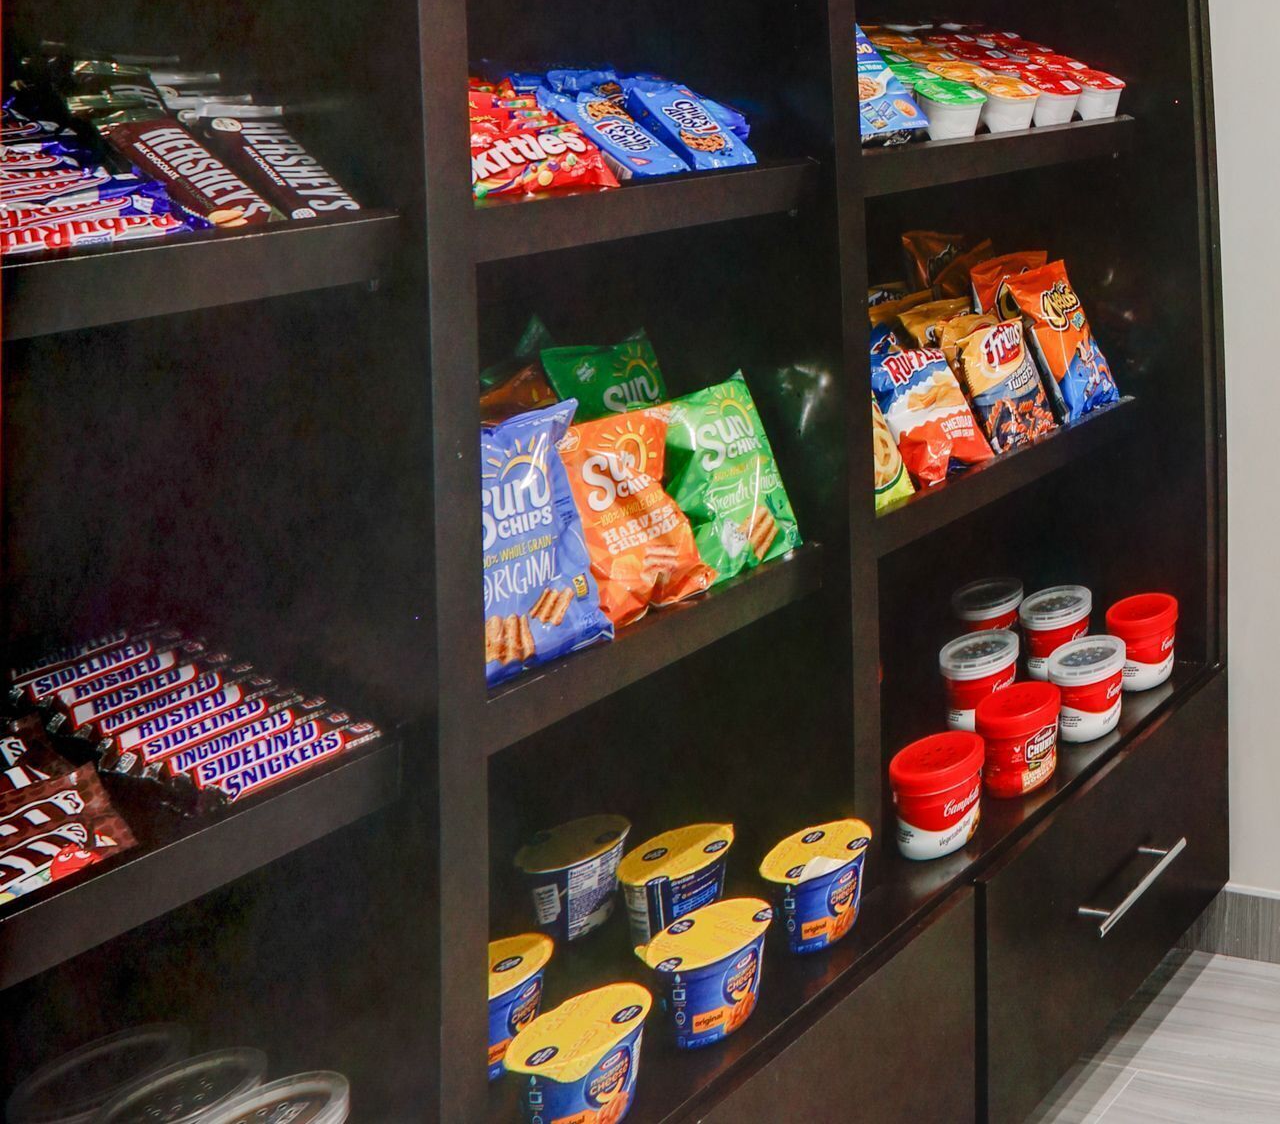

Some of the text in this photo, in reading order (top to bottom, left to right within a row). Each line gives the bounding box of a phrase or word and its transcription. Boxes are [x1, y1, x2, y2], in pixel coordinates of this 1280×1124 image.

[139, 128, 271, 218] HERSHEY'S
[146, 151, 180, 180] CHOCOLATE
[240, 122, 360, 211] HERSHEY'S
[472, 132, 587, 184] kittles
[980, 322, 1022, 368] Fritos
[603, 375, 660, 414] Sun
[1004, 366, 1034, 392] TWISTS
[697, 416, 755, 472] Sun
[941, 415, 973, 434] CHEDDAR
[617, 472, 654, 498] CHIP
[497, 507, 553, 540] CHIPS
[602, 504, 674, 546] HARVES
[621, 500, 646, 518] WHOLE
[500, 534, 552, 562] WHOLE GRAIN
[34, 640, 149, 695] SIDELINED
[75, 654, 161, 700] RUSHED
[92, 668, 182, 716] RUSHED
[138, 689, 227, 740] RUSHED
[148, 699, 262, 755] SIDELINED
[203, 721, 316, 781] SIDELINED
[226, 732, 340, 800] SNICKERS
[803, 921, 827, 934] original
[694, 1010, 724, 1028] original
